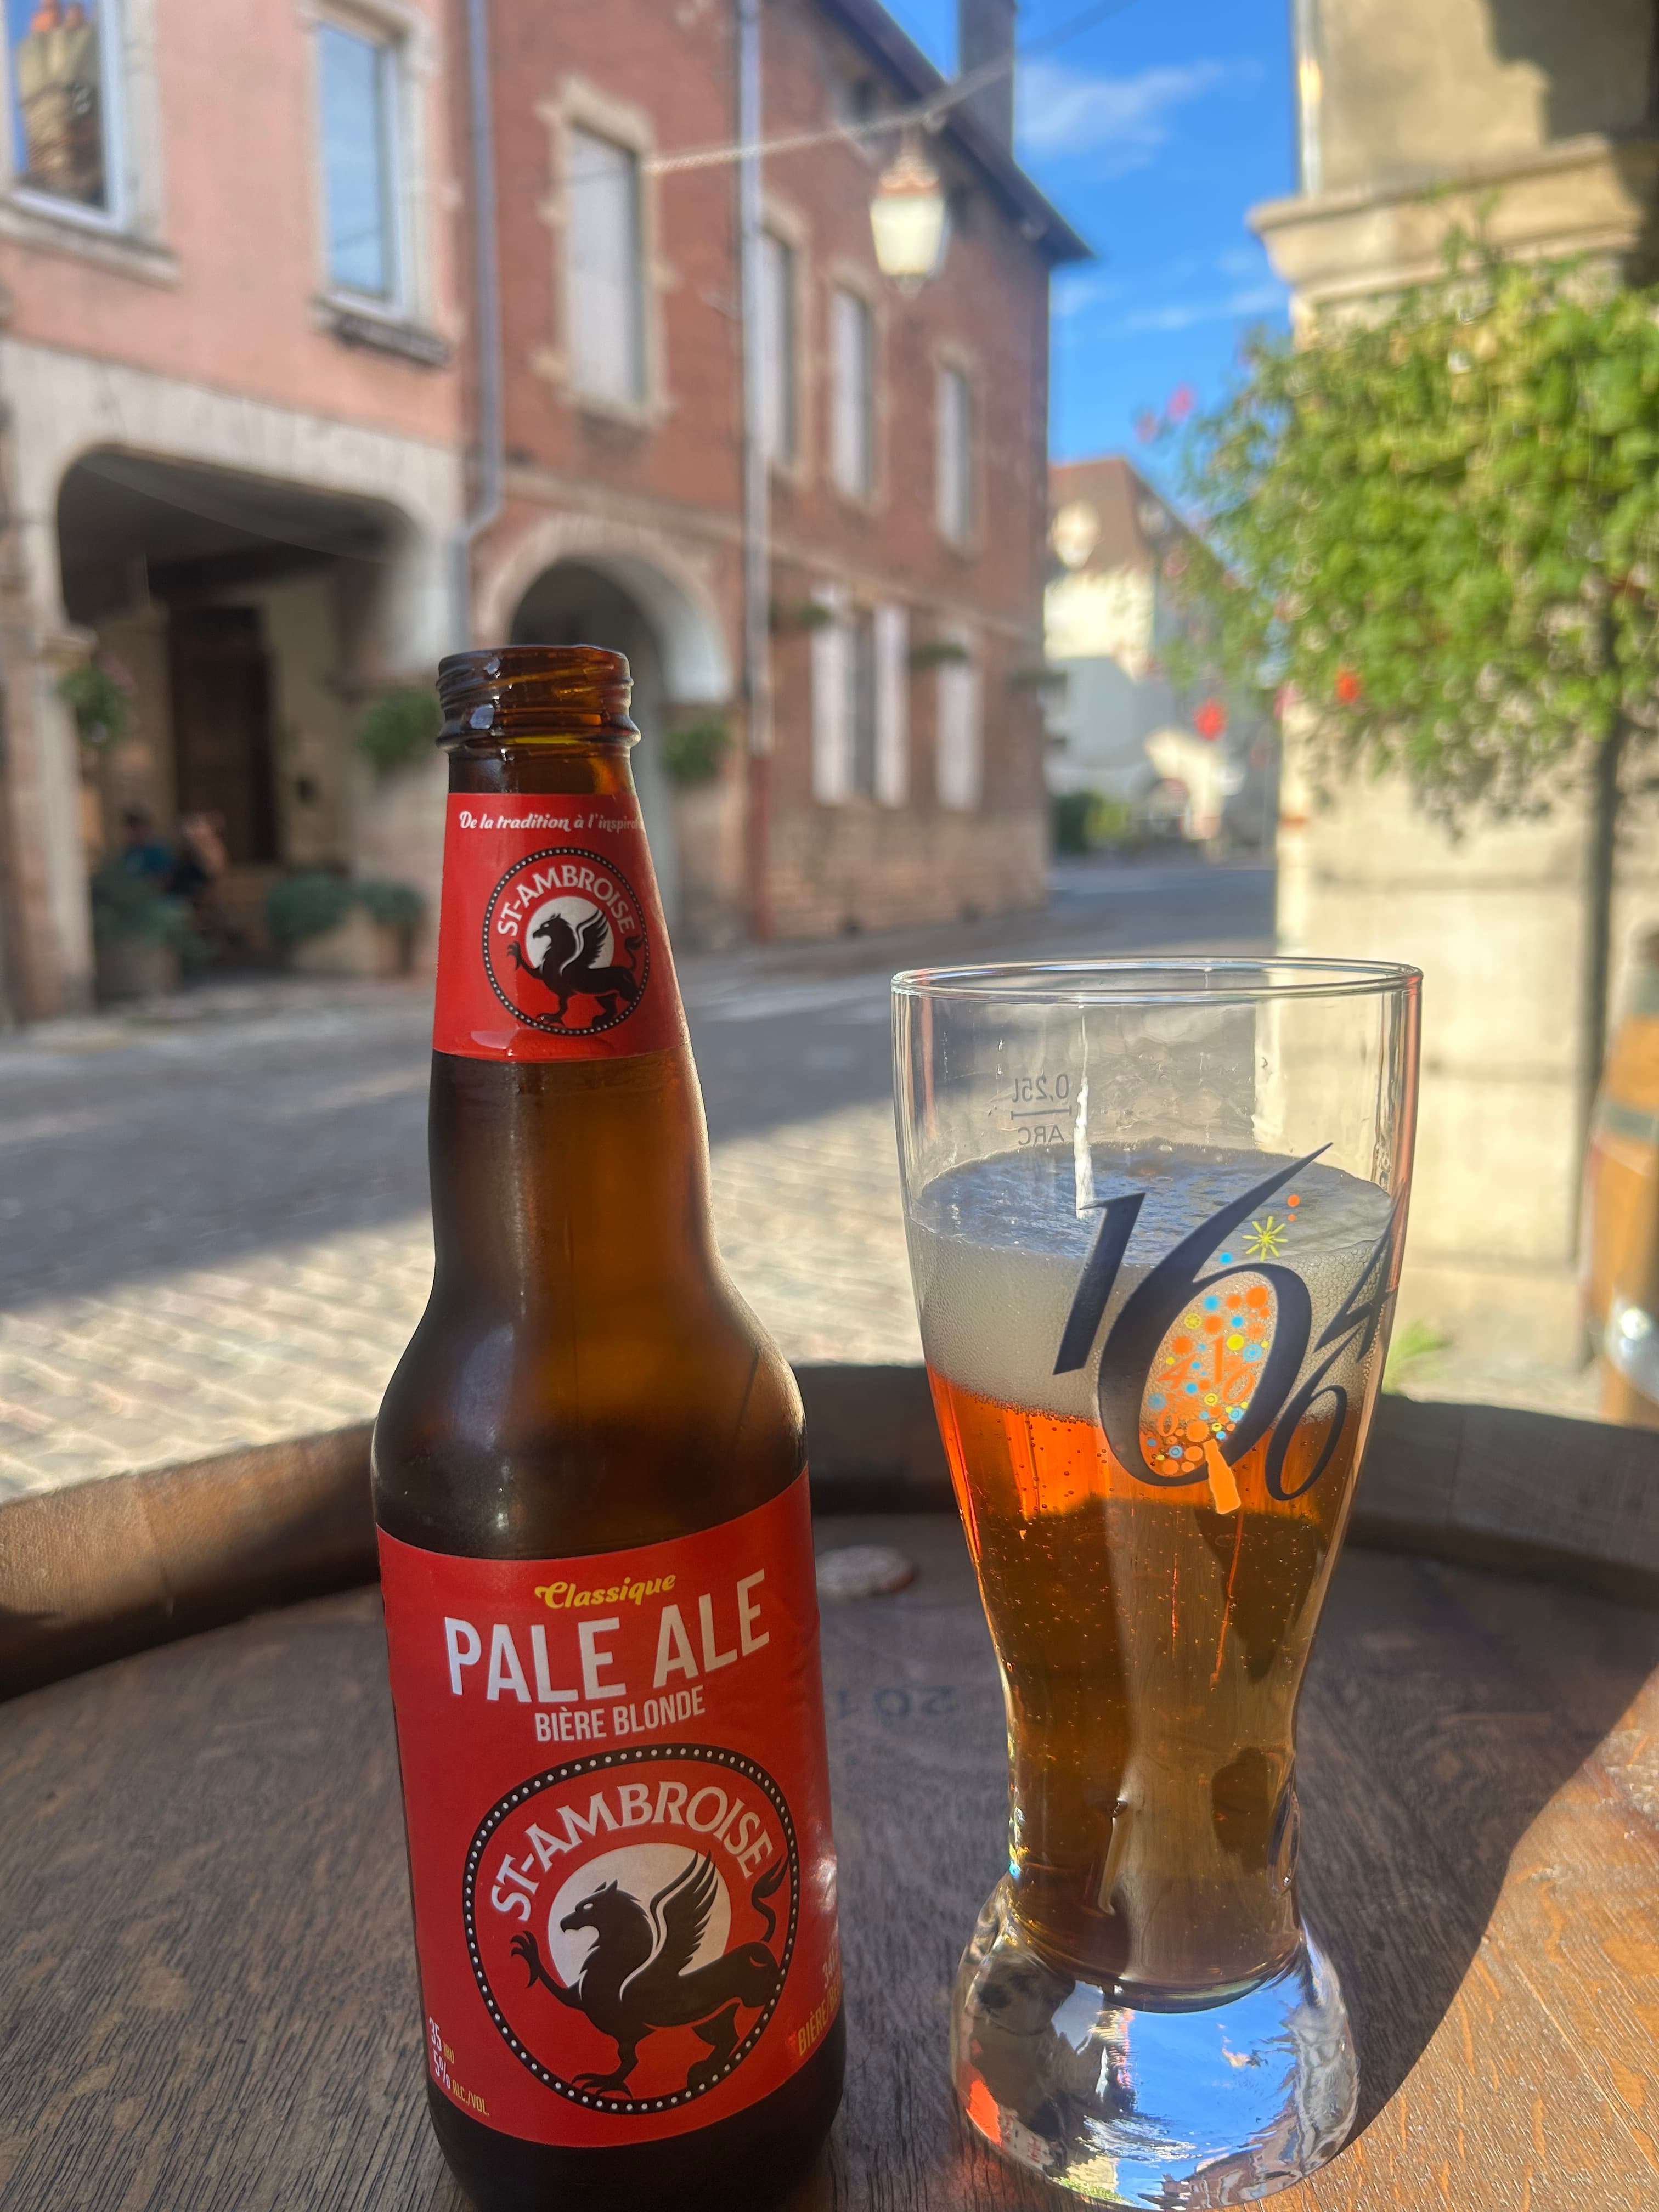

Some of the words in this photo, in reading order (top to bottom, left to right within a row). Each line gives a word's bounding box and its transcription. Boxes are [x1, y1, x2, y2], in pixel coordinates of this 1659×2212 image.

[459, 811, 477, 829] De
[479, 813, 494, 829] la
[496, 812, 571, 832] tradition
[573, 814, 584, 829] à
[497, 864, 635, 937] ST-AMBROISE
[534, 1573, 676, 1610] Classique
[444, 1616, 627, 1703] PALE
[653, 1568, 770, 1688] ALE
[535, 1706, 607, 1742] BIÈRE
[613, 1685, 706, 1735] BLONDE
[492, 1781, 775, 1922] ST-AMBROISE
[429, 2016, 442, 2052] 35
[443, 2041, 455, 2064] IBU
[433, 2049, 451, 2090] 5%
